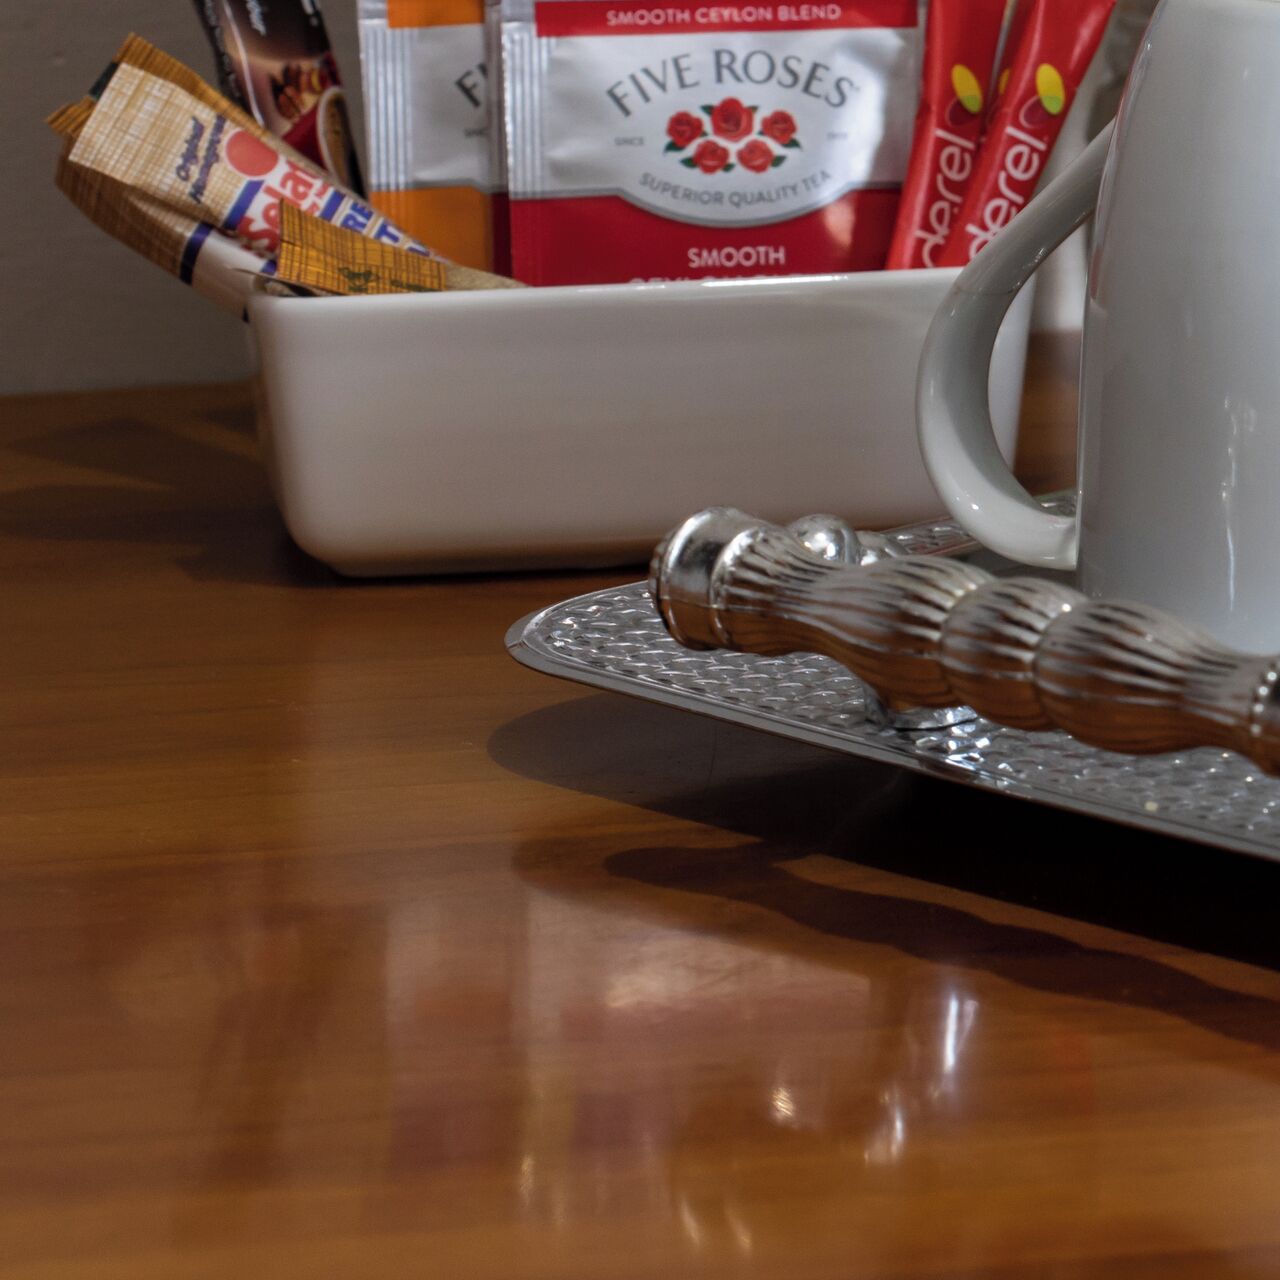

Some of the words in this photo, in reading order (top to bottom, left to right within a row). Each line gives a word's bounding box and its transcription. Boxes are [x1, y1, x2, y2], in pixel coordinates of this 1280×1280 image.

[606, 8, 690, 26] SMOOTH
[694, 5, 773, 24] CEYLON
[777, 3, 842, 22] BLEND
[606, 53, 700, 118] FIVE
[713, 48, 855, 109] ROSES
[638, 172, 724, 206] SUPERIOR
[729, 183, 799, 209] QUALITY
[802, 170, 832, 190] TEA
[687, 246, 786, 268] SMOOTH
